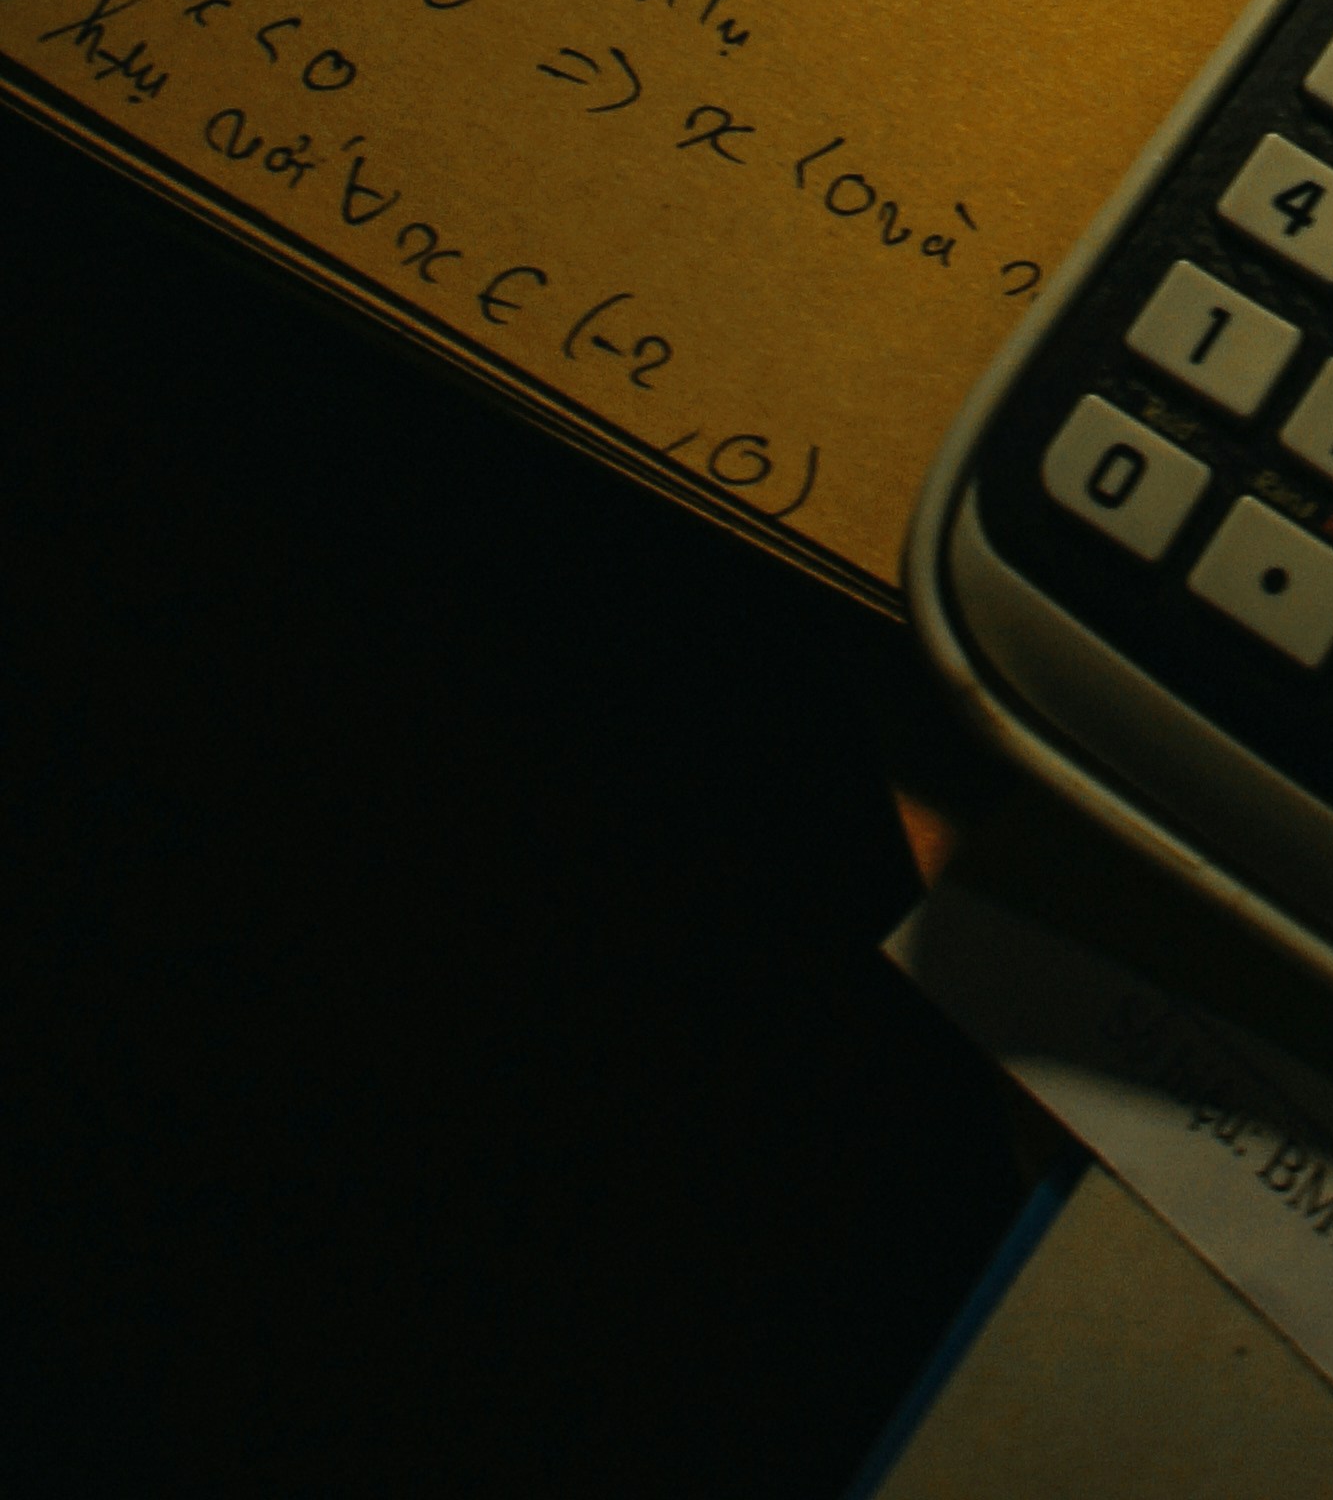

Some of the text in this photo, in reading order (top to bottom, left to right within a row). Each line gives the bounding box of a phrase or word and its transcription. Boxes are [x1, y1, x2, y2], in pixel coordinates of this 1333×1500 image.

[1268, 173, 1322, 240] 4
[1185, 304, 1234, 369] 1
[1086, 438, 1150, 513] 0
